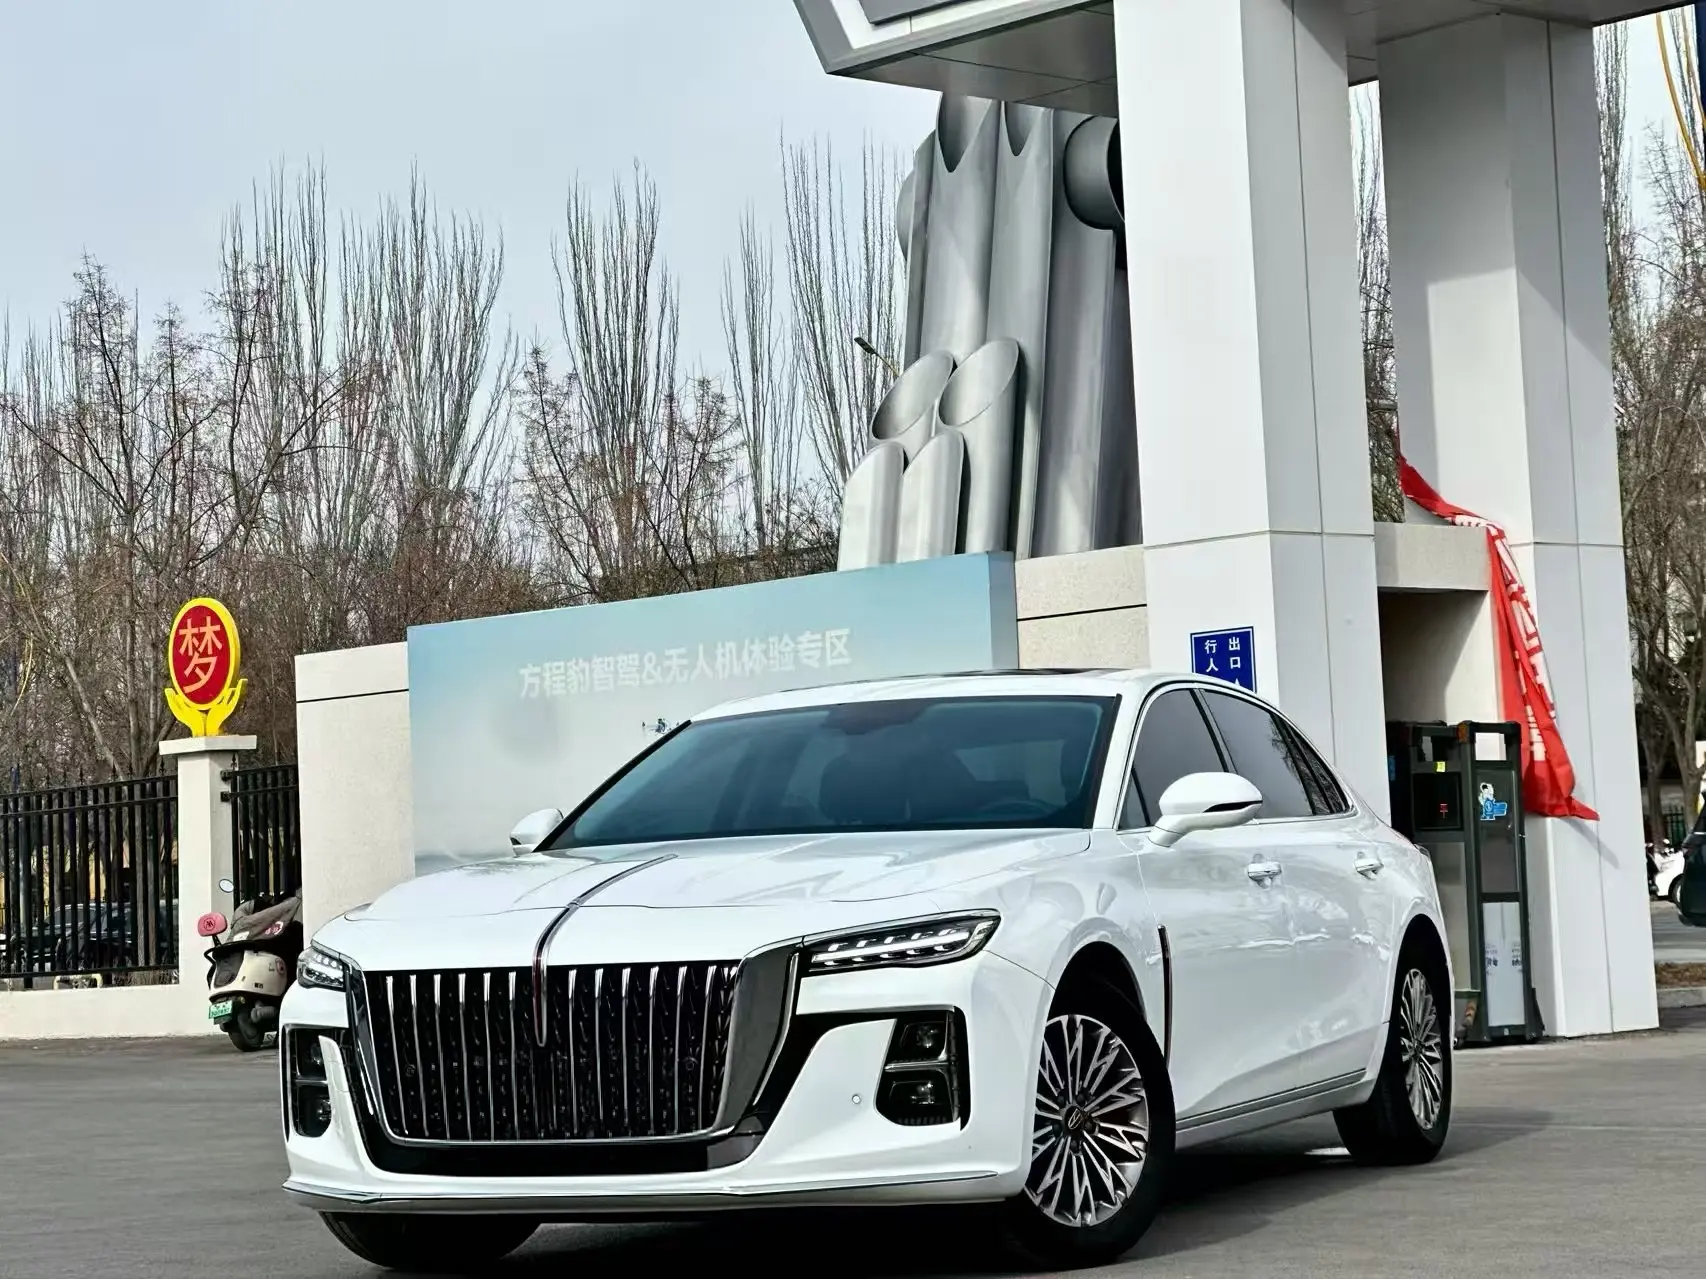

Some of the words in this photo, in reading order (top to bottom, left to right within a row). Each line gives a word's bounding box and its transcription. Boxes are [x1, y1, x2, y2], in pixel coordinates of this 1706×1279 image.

[179, 615, 223, 694] 梦
[519, 628, 851, 699] 方程豹智驾&无人机体验专区
[1204, 639, 1219, 673] 行人
[1228, 636, 1241, 669] 出口
